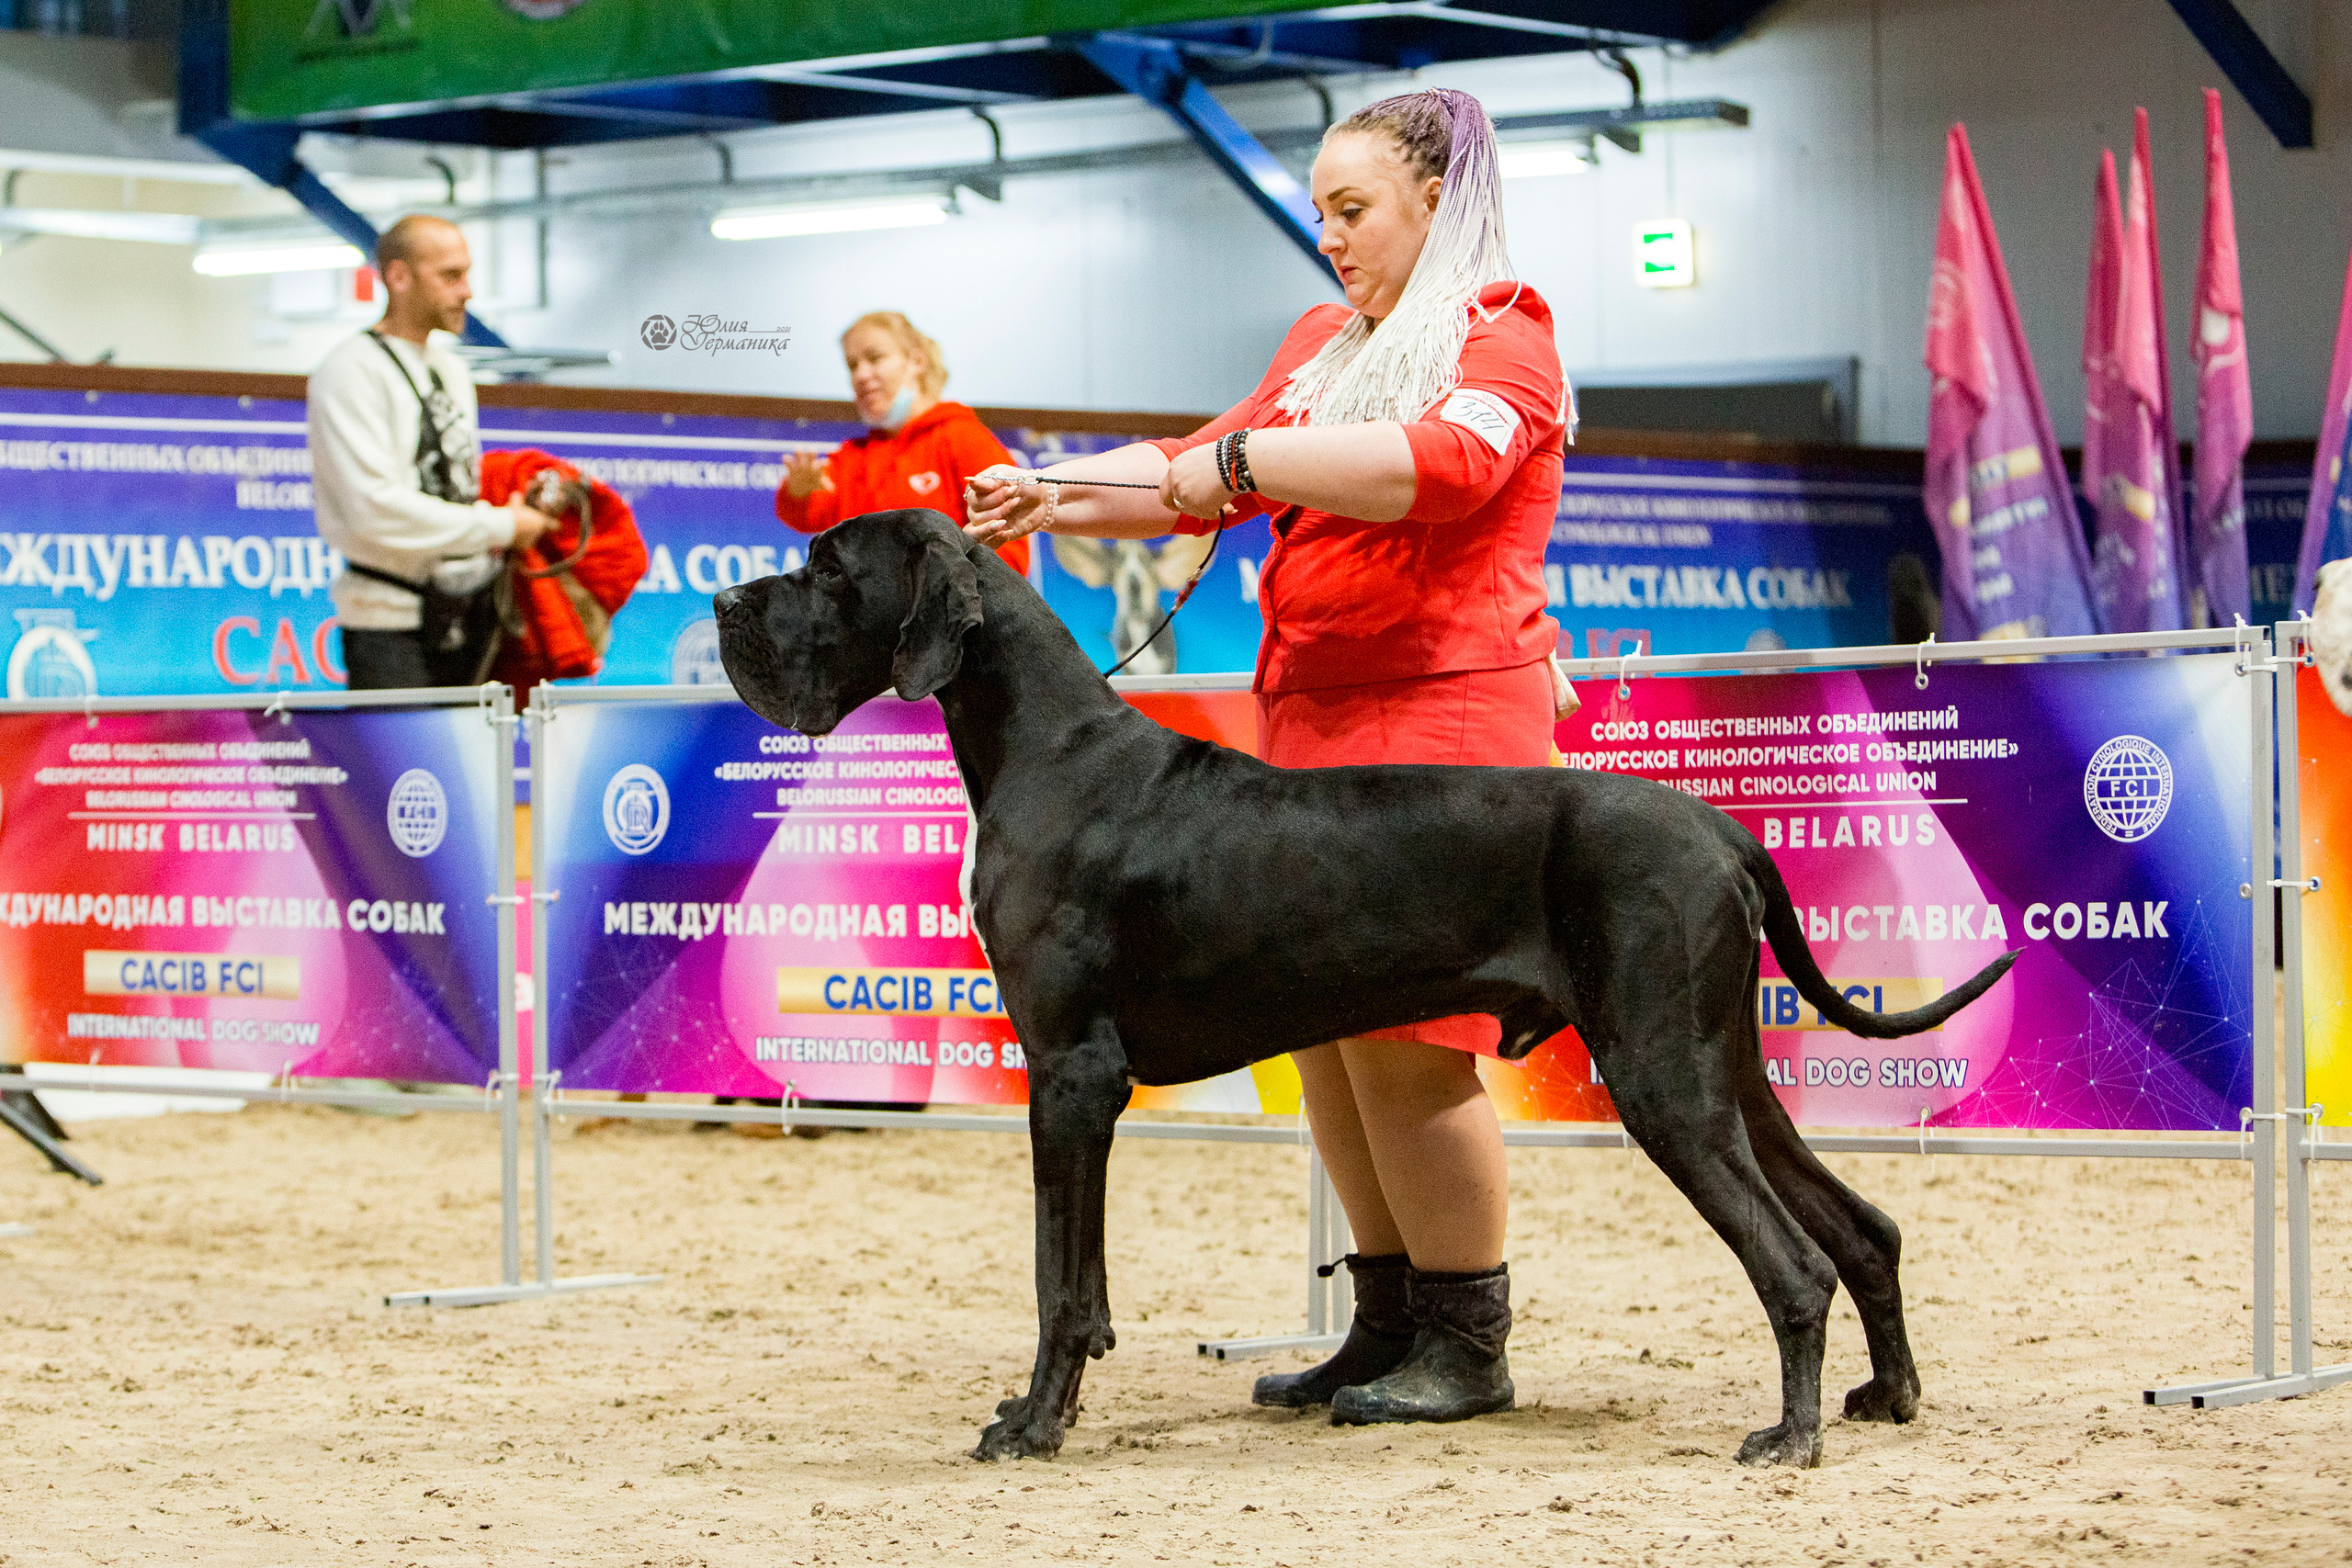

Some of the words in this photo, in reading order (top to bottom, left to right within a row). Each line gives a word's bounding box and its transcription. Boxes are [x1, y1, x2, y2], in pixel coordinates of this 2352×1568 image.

[0, 533, 345, 602] ЖДУНАРОДН
[212, 615, 348, 686] CAC
[1590, 720, 1650, 742] СОЮЗ
[1655, 715, 1812, 740] ОБЩЕСТВЕННЫХ
[1816, 705, 1960, 734] ОБЪЕДИНЕНИЙ
[759, 735, 810, 754] СОЮЗ
[813, 733, 948, 755] ОБЩЕСТВЕННЫХ
[1559, 749, 1679, 771] ЕЛОРУССКОЕ
[1685, 743, 1860, 769] КИНОЛОГИЧЕСКОЕ
[1866, 738, 2020, 763] ОБЪЕДИНЕНИЕ»
[2091, 739, 2152, 773] CYNOLOGIQUE
[838, 760, 961, 780] КИНОЛОГИЧЕС
[1740, 773, 1871, 796] CINOLOGICAL
[1875, 770, 1938, 793] UNION
[776, 787, 882, 807] BELORUSSIAN
[886, 787, 967, 806] CINOLOGI
[2086, 773, 2118, 834] FEDERATION
[2110, 779, 2148, 797] FCI
[2142, 750, 2170, 833] INTERNATIONALE
[86, 823, 165, 852] MINSK
[178, 823, 296, 852] BELARUS
[778, 823, 880, 854] MINSK
[1763, 813, 1937, 850] BELARUS
[191, 895, 341, 931] ВЫСТАВКА
[346, 897, 447, 935] СОБАК
[604, 902, 909, 942] МЕЖДУНАРОДНАЯ
[2022, 900, 2170, 941] СОБАК
[120, 958, 208, 992] CACIB
[219, 961, 264, 994] FCI
[822, 974, 933, 1012] CACIB
[67, 1012, 208, 1041] INTERNATIONAL
[210, 1019, 258, 1043] DOG
[261, 1021, 320, 1046] SHOW
[755, 1036, 933, 1066] INTERNATIONAL
[938, 1040, 994, 1069] DOG
[1805, 1058, 1871, 1089] DOG
[1879, 1057, 1969, 1089] SHOW
